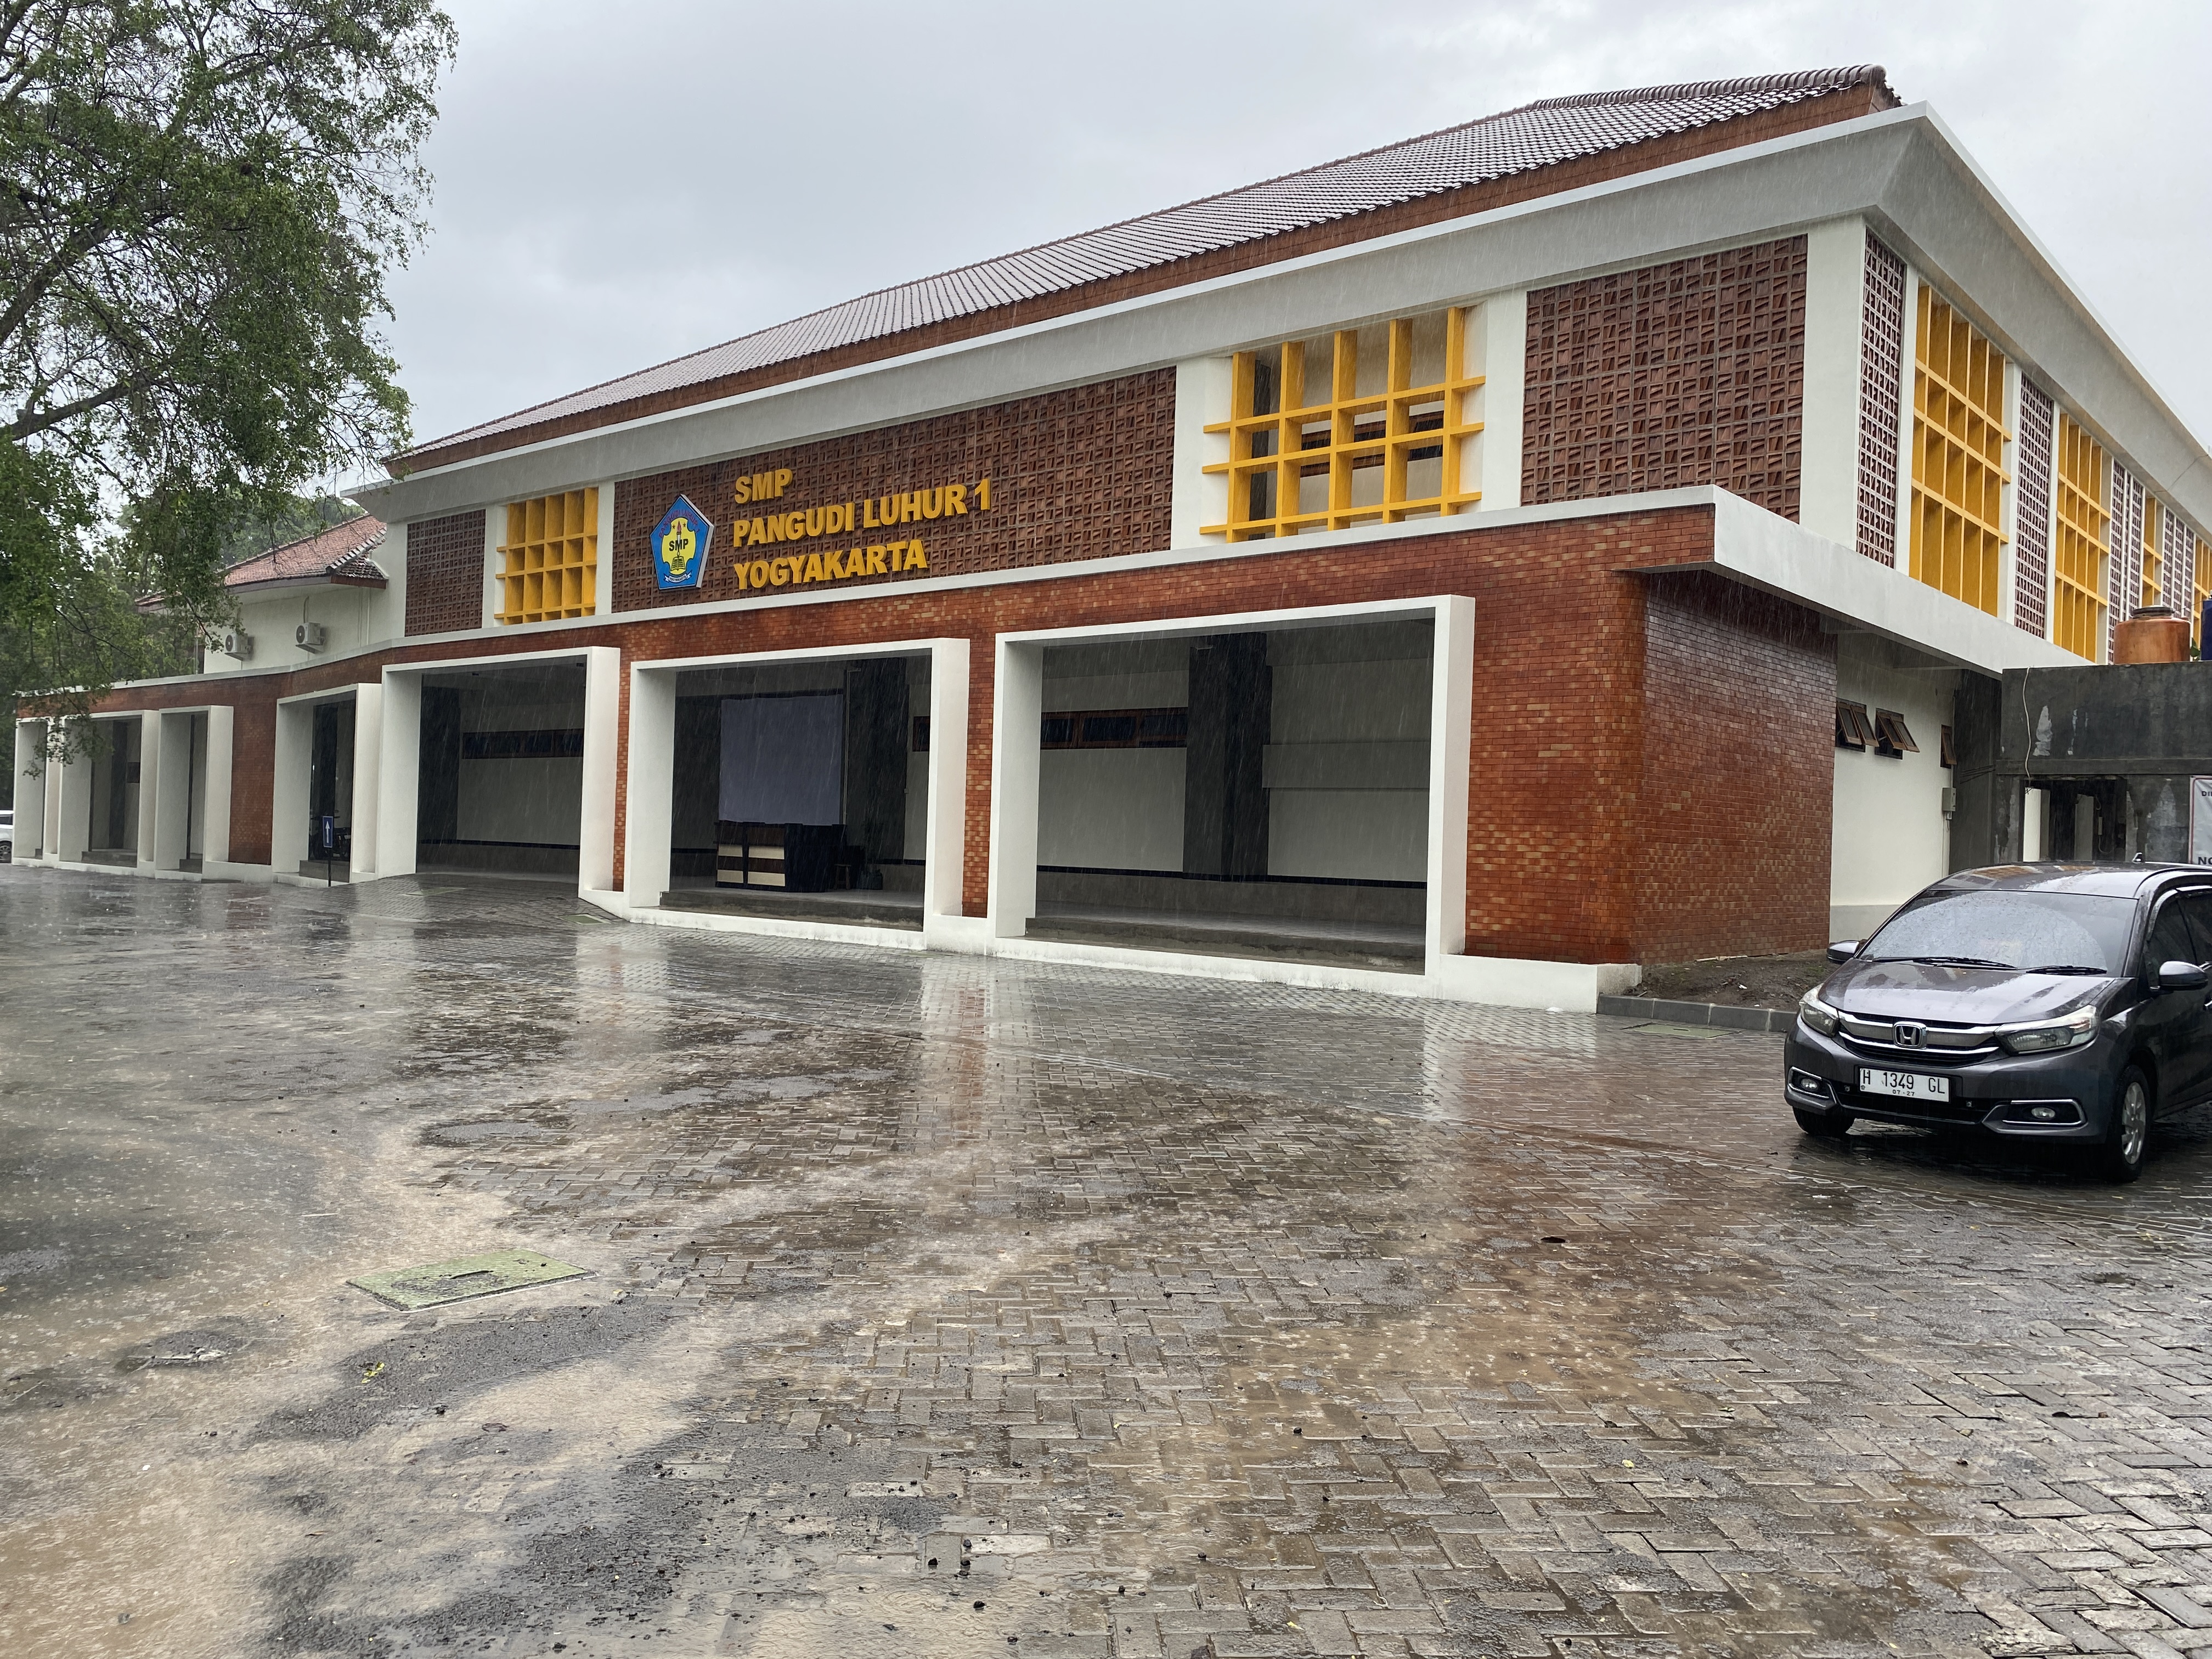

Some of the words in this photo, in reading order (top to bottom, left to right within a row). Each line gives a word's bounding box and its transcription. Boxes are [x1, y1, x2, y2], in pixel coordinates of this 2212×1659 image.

[735, 469, 793, 505] SMP
[733, 501, 856, 548] PANGUDI
[863, 484, 969, 528] LUHUR
[974, 478, 991, 511] 1
[669, 539, 689, 551] SMP
[733, 539, 928, 590] YOGYAKARTA
[1863, 1069, 1871, 1085] H
[1883, 1071, 1914, 1090] 1349
[1928, 1077, 1945, 1094] GL
